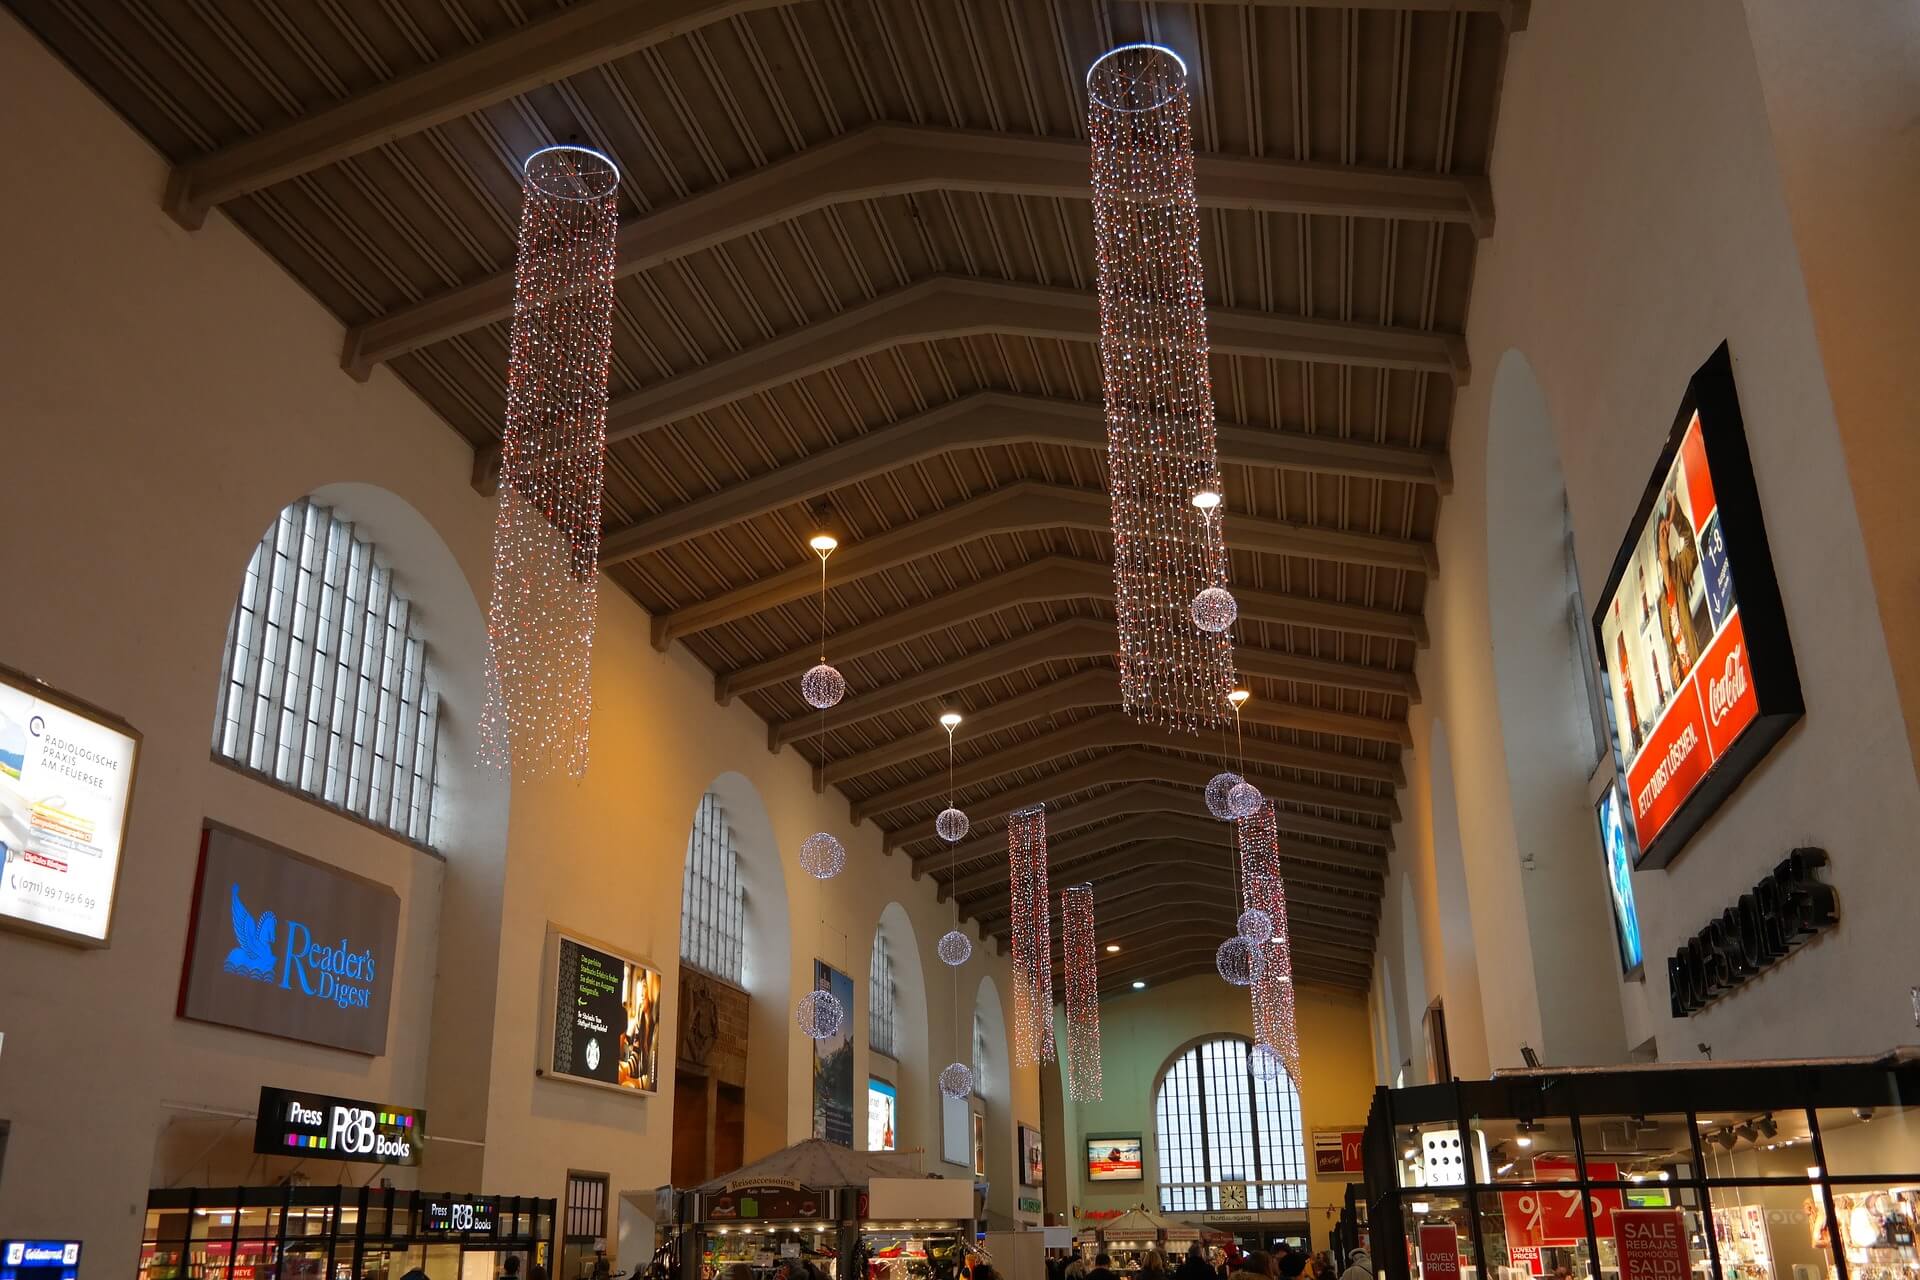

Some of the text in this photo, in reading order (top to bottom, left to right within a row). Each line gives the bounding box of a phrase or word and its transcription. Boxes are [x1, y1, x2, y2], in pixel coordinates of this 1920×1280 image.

[43, 746, 76, 766] PRAXIS
[45, 734, 118, 770] RADIOLOGISCHE
[41, 758, 104, 789] AM FEUERSEE
[1637, 782, 1653, 820] JETZT
[1650, 758, 1670, 800] DURST
[279, 920, 376, 996] Reader's
[318, 971, 371, 1009] Digest
[290, 1101, 323, 1126] Press
[377, 1135, 410, 1157] Books
[1433, 1172, 1463, 1182] SIX
[431, 1203, 448, 1216] Press
[474, 1218, 492, 1230] Books
[1624, 1223, 1677, 1239] SALE
[1626, 1239, 1678, 1249] REBAJAS
[1425, 1253, 1455, 1262] LOVELY
[1426, 1262, 1457, 1272] PRICES
[1629, 1259, 1682, 1274] SALDI
